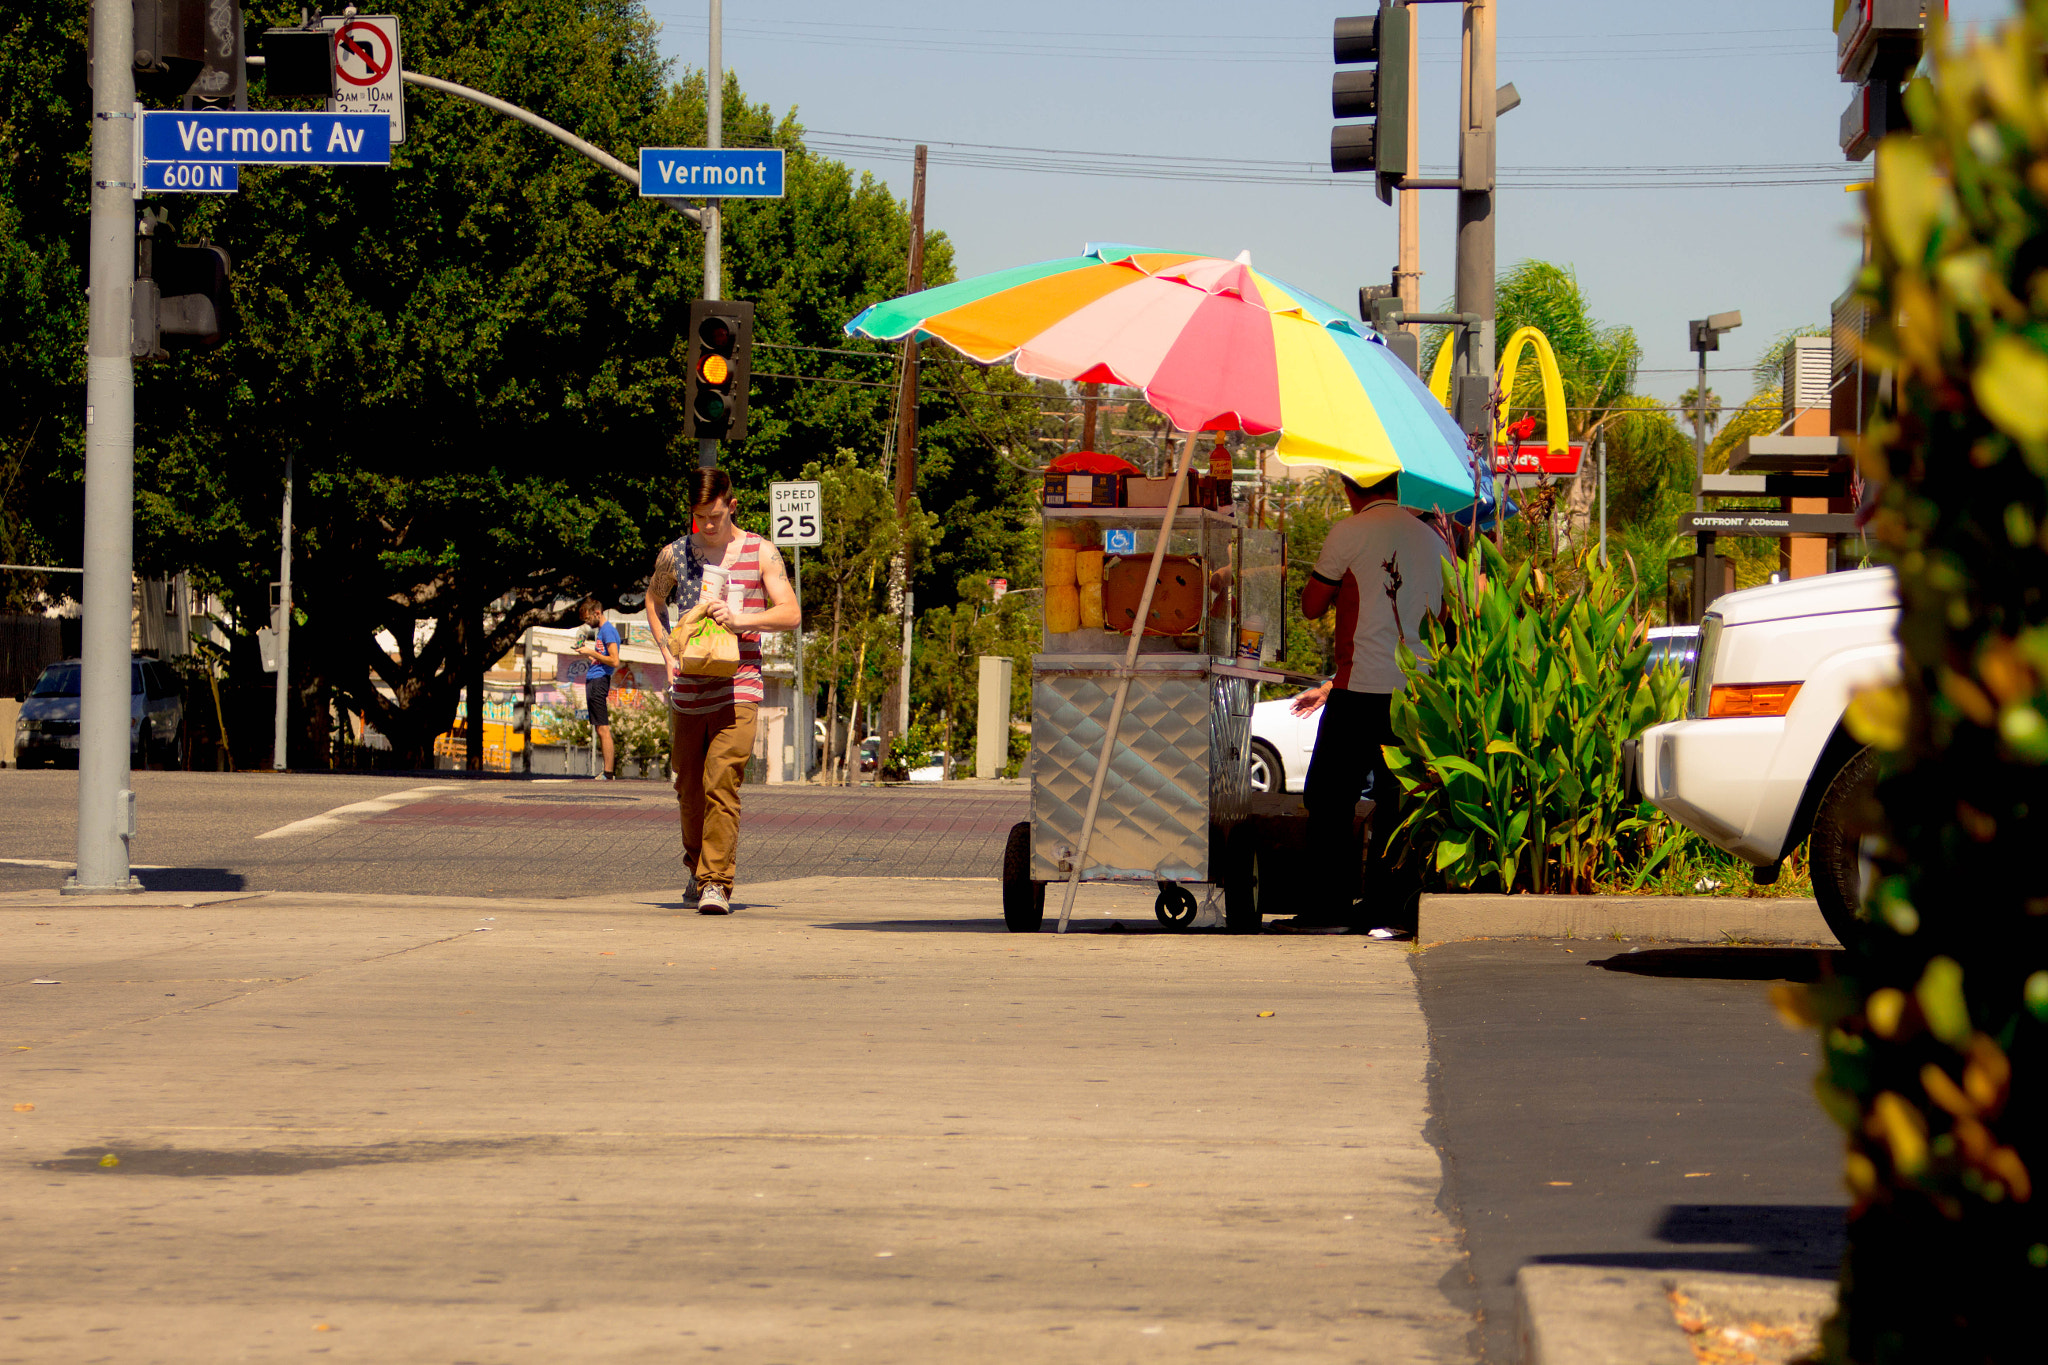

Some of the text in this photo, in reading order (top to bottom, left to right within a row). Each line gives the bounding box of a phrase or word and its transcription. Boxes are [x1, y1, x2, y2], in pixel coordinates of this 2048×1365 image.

[335, 88, 358, 102] 6AM
[367, 87, 393, 102] 10AM
[177, 121, 365, 152] Vermont Av
[163, 165, 223, 188] 600 N
[658, 160, 767, 185] Vermont
[775, 490, 816, 500] SPEED
[779, 502, 811, 512] LIMIT
[777, 515, 816, 538] 25
[1692, 517, 1744, 526] OUTFRONT
[1748, 518, 1789, 527] JCDecaux
